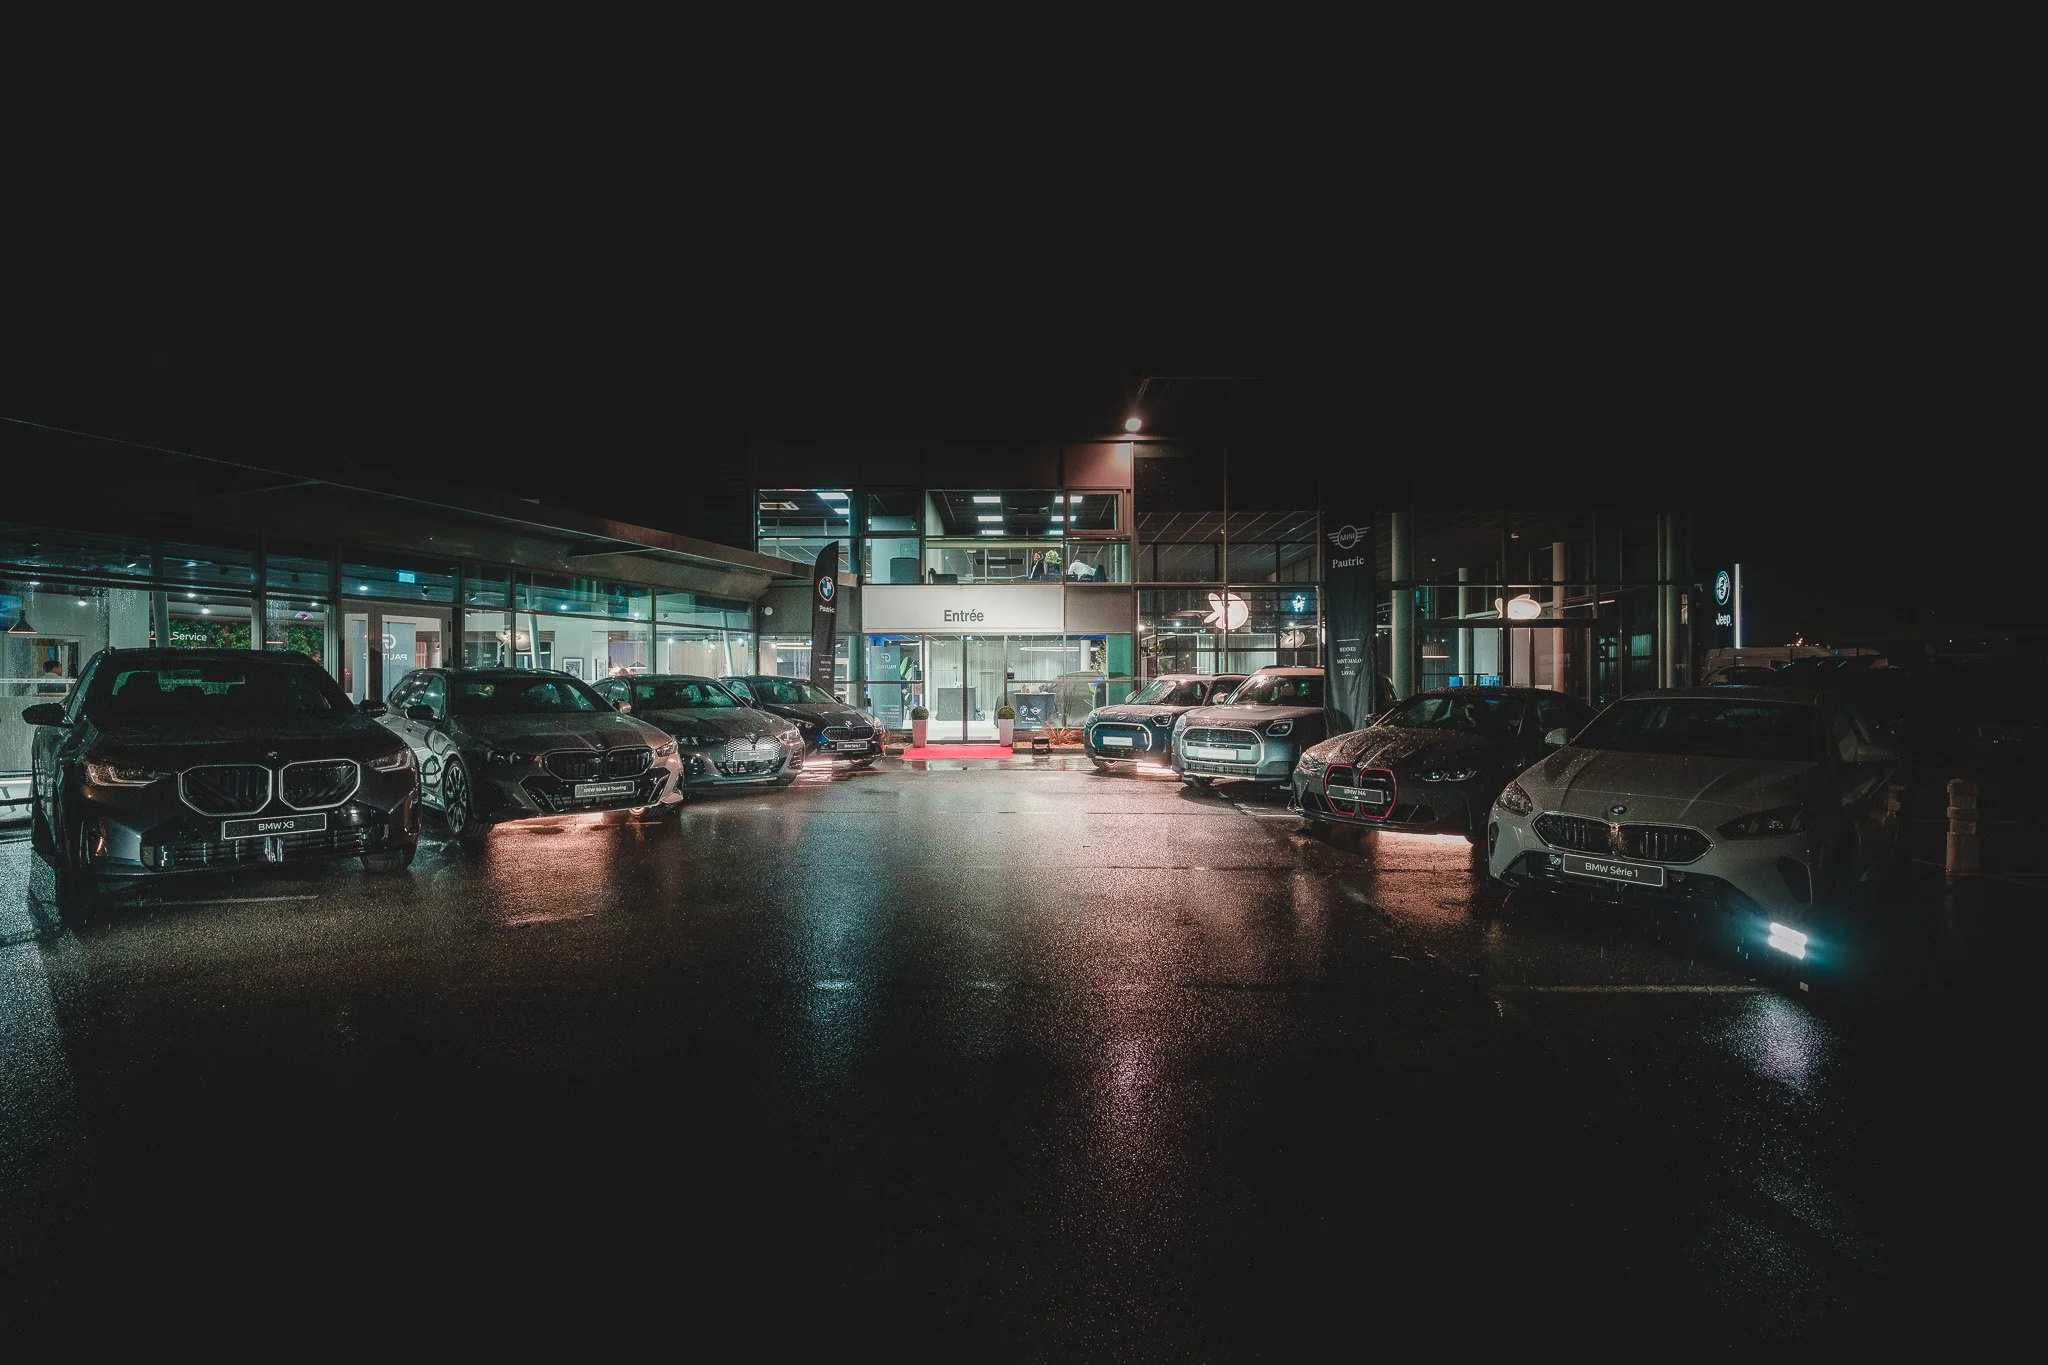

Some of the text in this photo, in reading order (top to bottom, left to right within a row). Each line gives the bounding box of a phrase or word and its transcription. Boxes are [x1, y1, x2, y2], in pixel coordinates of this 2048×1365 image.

[1340, 532, 1355, 541] MINI
[1332, 556, 1364, 568] Pautric
[944, 609, 984, 622] Entrée
[1715, 613, 1731, 627] Jeep
[172, 631, 207, 641] Service
[258, 820, 295, 831] BMW X3
[1585, 862, 1638, 877] BMW Série 1
